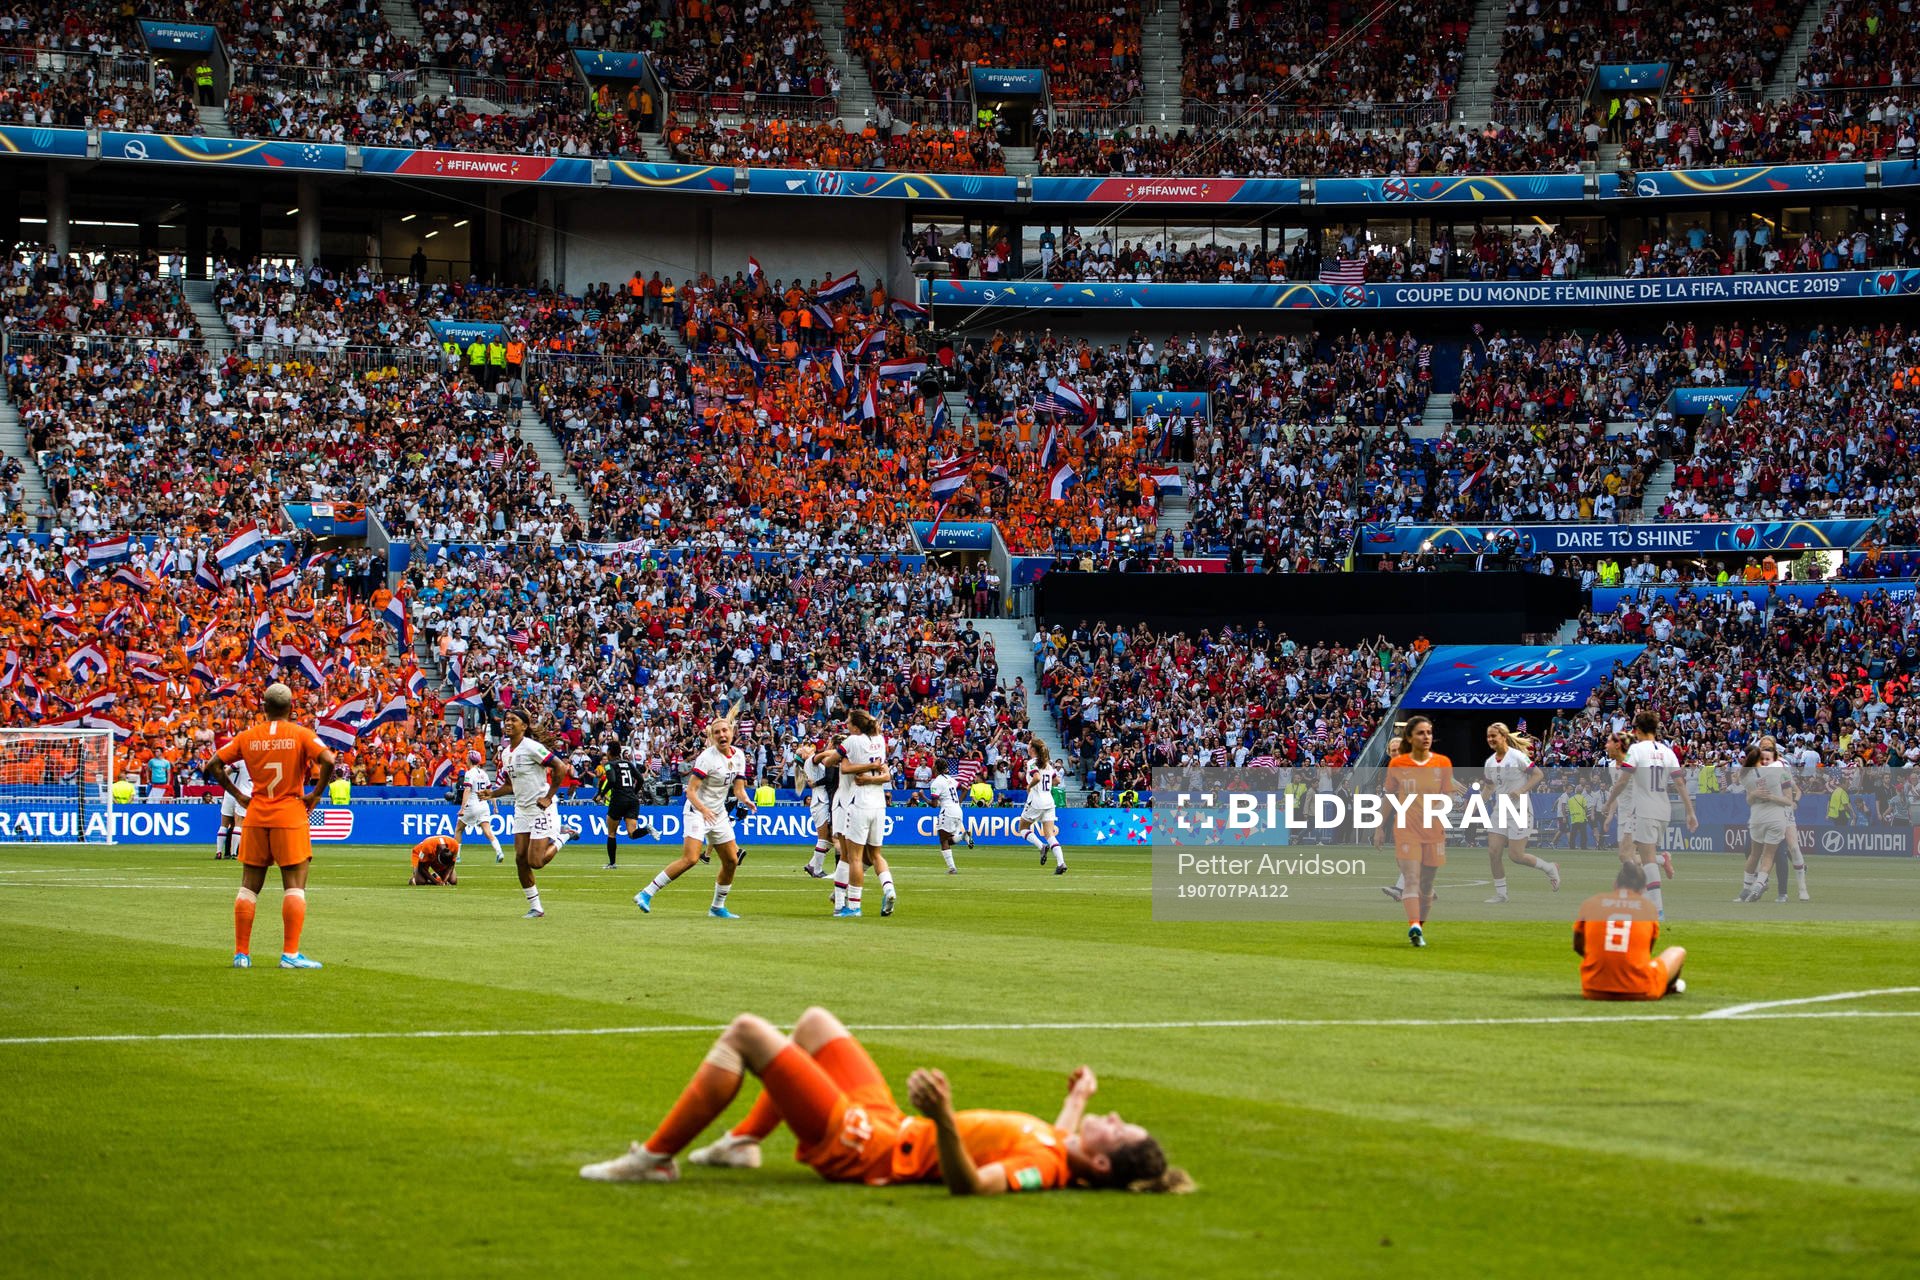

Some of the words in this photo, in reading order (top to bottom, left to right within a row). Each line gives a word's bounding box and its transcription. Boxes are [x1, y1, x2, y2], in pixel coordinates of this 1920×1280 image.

[157, 30, 199, 39] #FIFAWWC
[447, 160, 508, 173] #FIFAWWC
[1137, 186, 1197, 196] #FIFAWWC
[1396, 288, 1453, 302] COUPE
[1458, 287, 1482, 302] DU
[1487, 286, 1550, 302] MONDE
[1554, 284, 1635, 301] FÉMININE
[1640, 284, 1661, 298] DE
[1666, 283, 1687, 297] LA
[1691, 282, 1729, 297] FIFA,
[1732, 279, 1799, 296] FRANCE
[445, 329, 487, 338] #FIFAWWC
[936, 529, 975, 537] FIFAWWC
[1556, 532, 1603, 547] DARE
[1608, 531, 1633, 546] TO
[1421, 695, 1517, 705] FRANCE
[250, 740, 261, 751] VAN
[261, 740, 271, 750] DE
[271, 738, 296, 750] SANDEN
[263, 762, 283, 799] 7
[620, 769, 633, 787] 21
[1042, 774, 1050, 792] 12
[1649, 765, 1665, 792] 10
[401, 813, 455, 836] FIFA
[741, 815, 818, 837] FRANC
[534, 817, 548, 831] 22
[1847, 833, 1906, 851] HYUNDAI
[1604, 914, 1632, 952] 8
